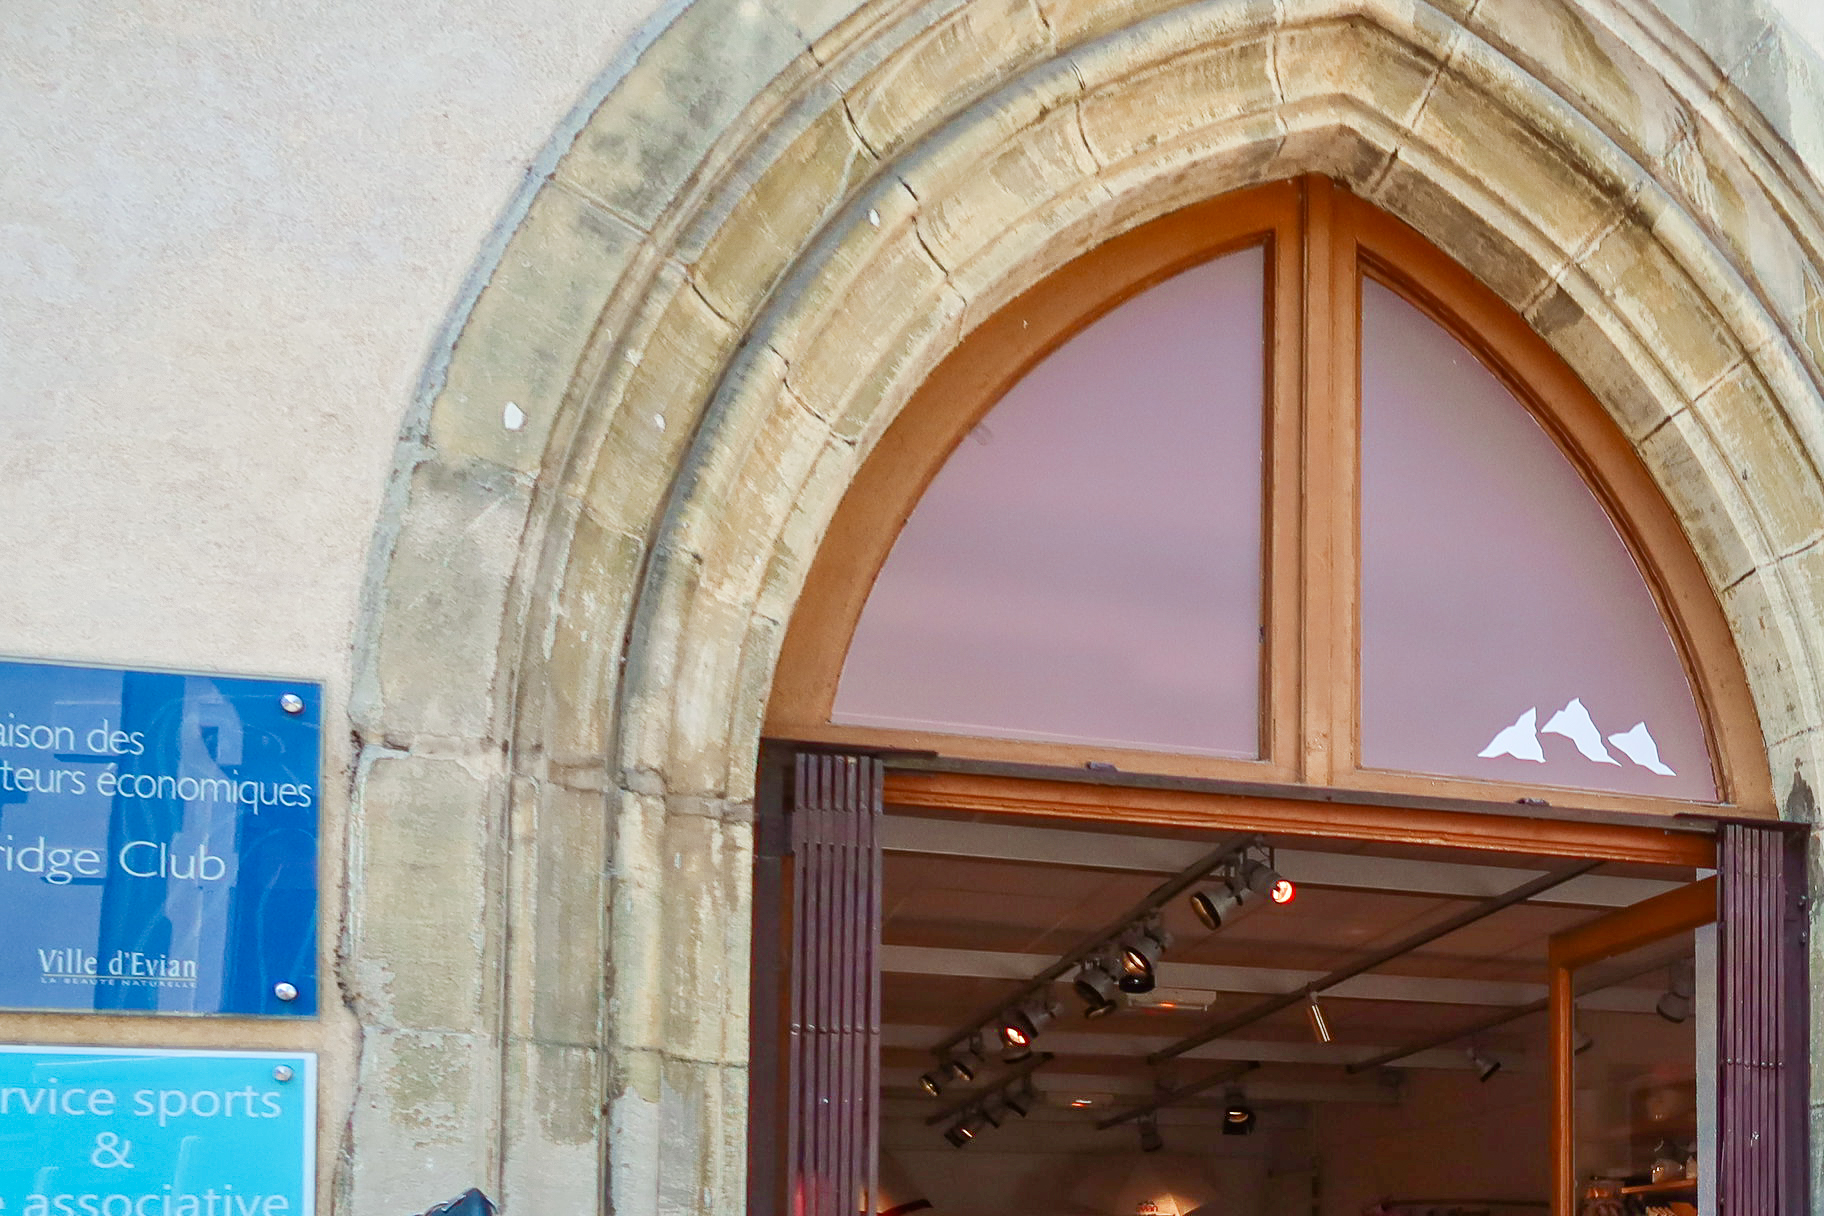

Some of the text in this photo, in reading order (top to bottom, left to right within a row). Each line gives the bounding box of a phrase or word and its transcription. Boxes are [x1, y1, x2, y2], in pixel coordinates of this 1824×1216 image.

[86, 718, 145, 755] des
[0, 760, 312, 815] teurs économiques
[119, 840, 226, 881] Club
[38, 948, 198, 978] Ville d'Evian
[0, 1077, 283, 1128] rvice sports
[91, 1131, 135, 1169] &
